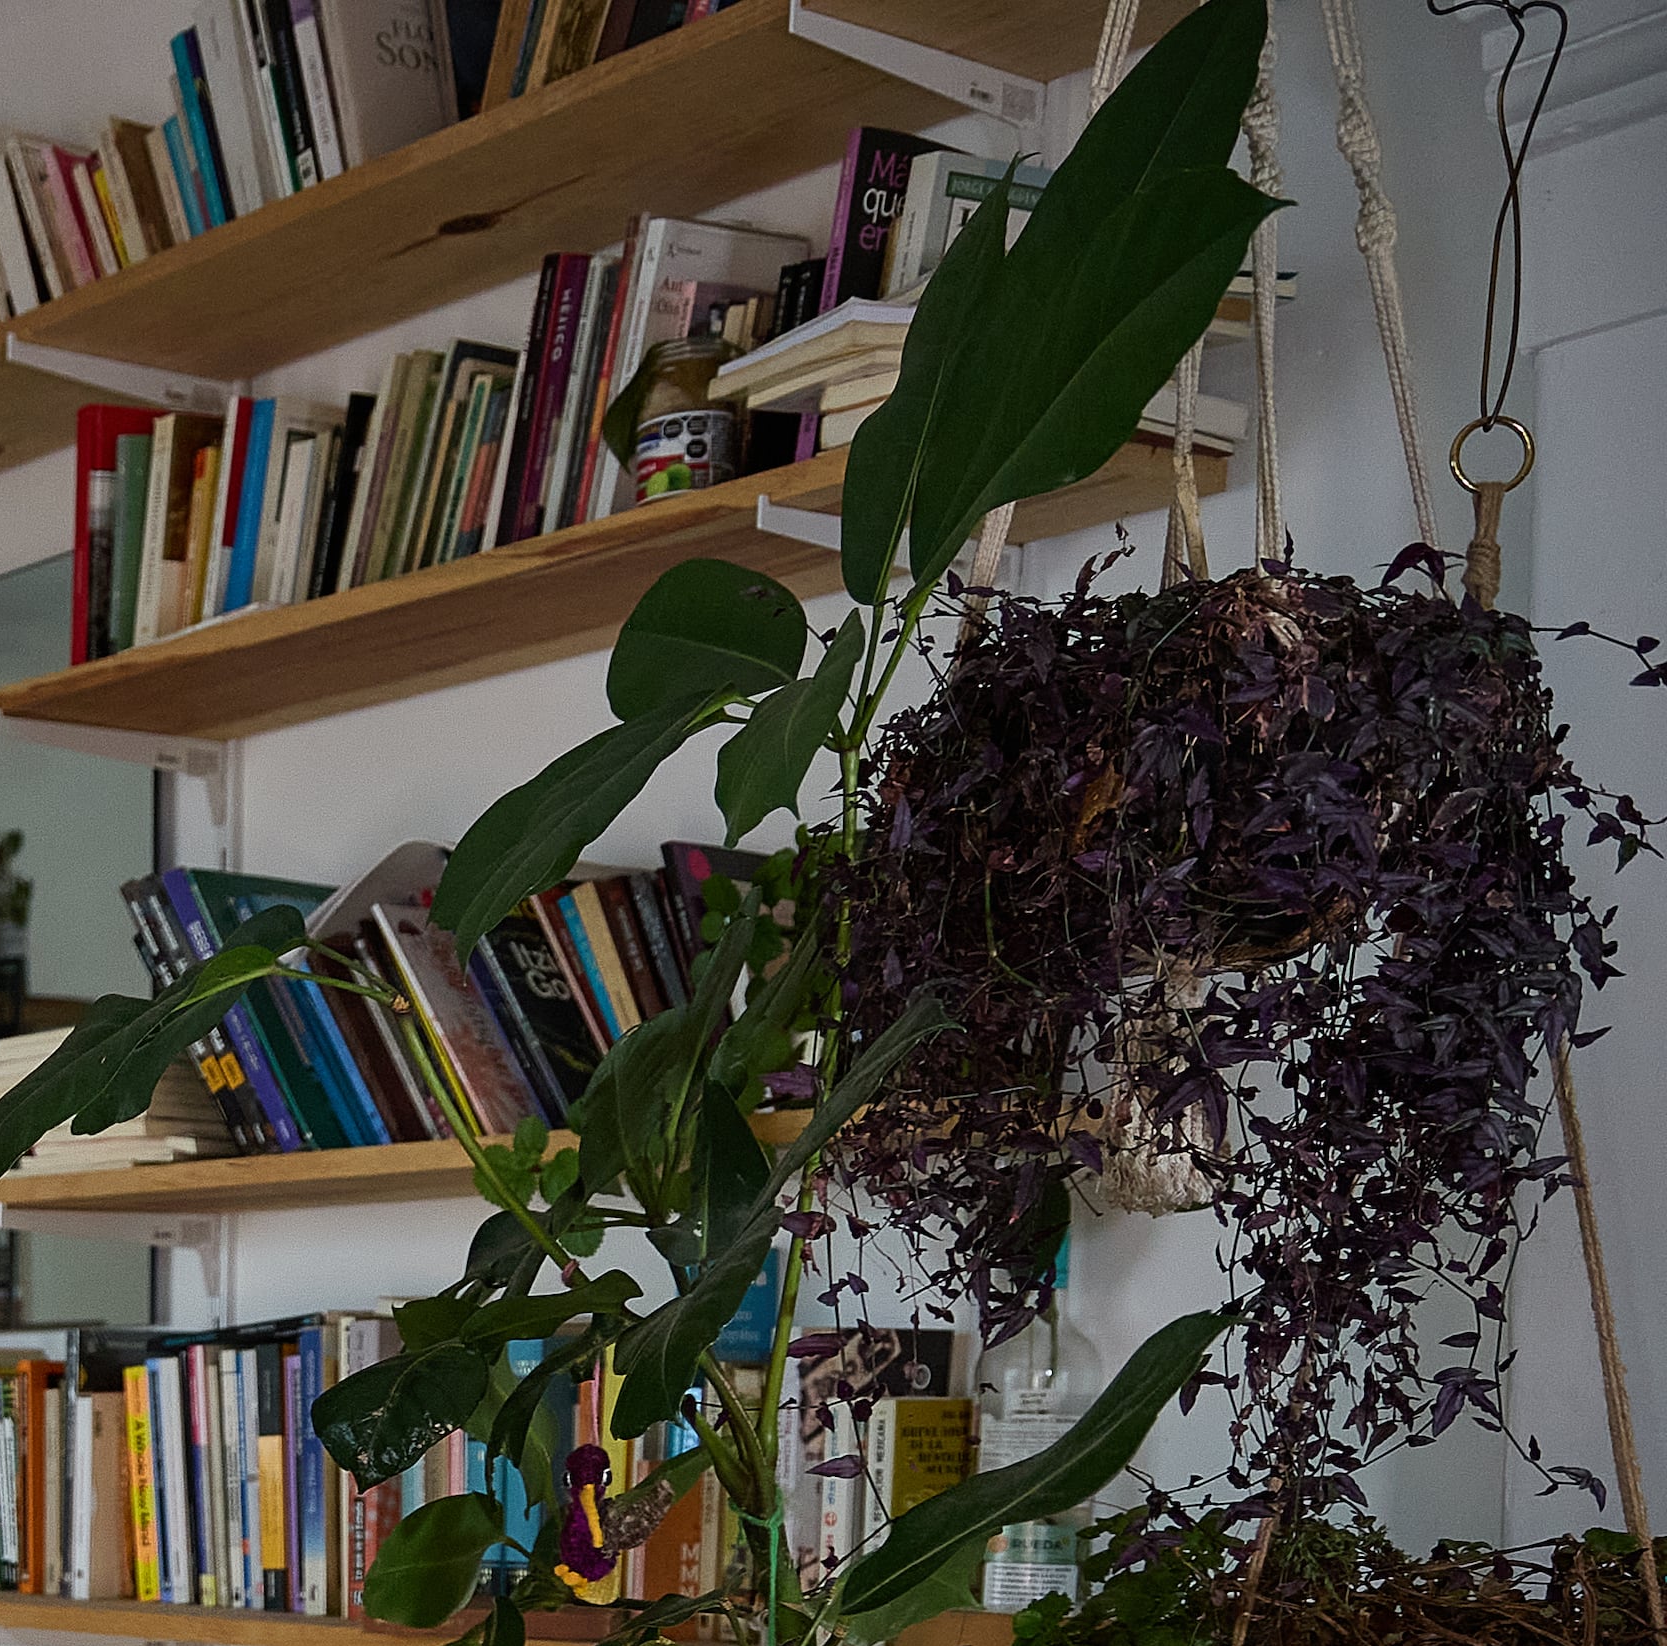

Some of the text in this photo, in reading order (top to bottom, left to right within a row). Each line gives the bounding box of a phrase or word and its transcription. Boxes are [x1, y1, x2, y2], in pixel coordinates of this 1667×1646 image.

[868, 148, 910, 190] Má
[134, 1433, 147, 1476] Whole
[136, 1477, 150, 1510] New
[1011, 1539, 1063, 1550] RUEDA
